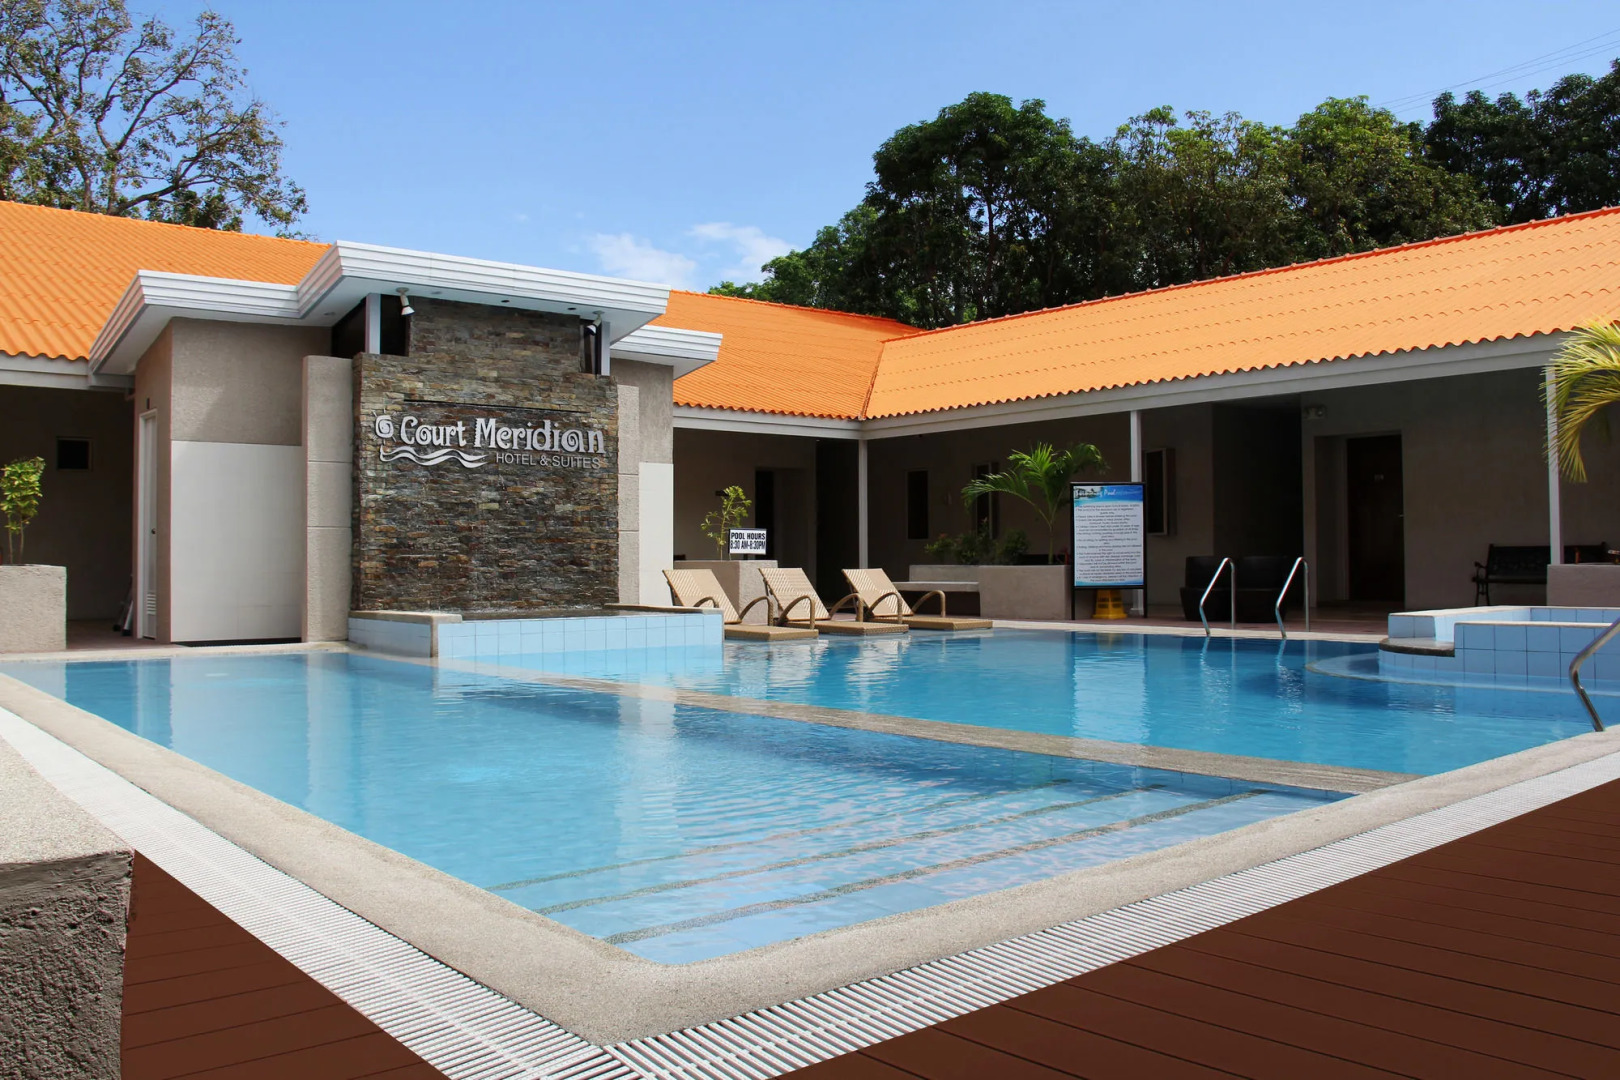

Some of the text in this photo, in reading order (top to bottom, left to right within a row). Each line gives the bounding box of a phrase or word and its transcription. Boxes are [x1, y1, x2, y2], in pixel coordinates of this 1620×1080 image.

[400, 415, 607, 454] Court Meridian
[496, 452, 601, 470] HOTEL & SUITES
